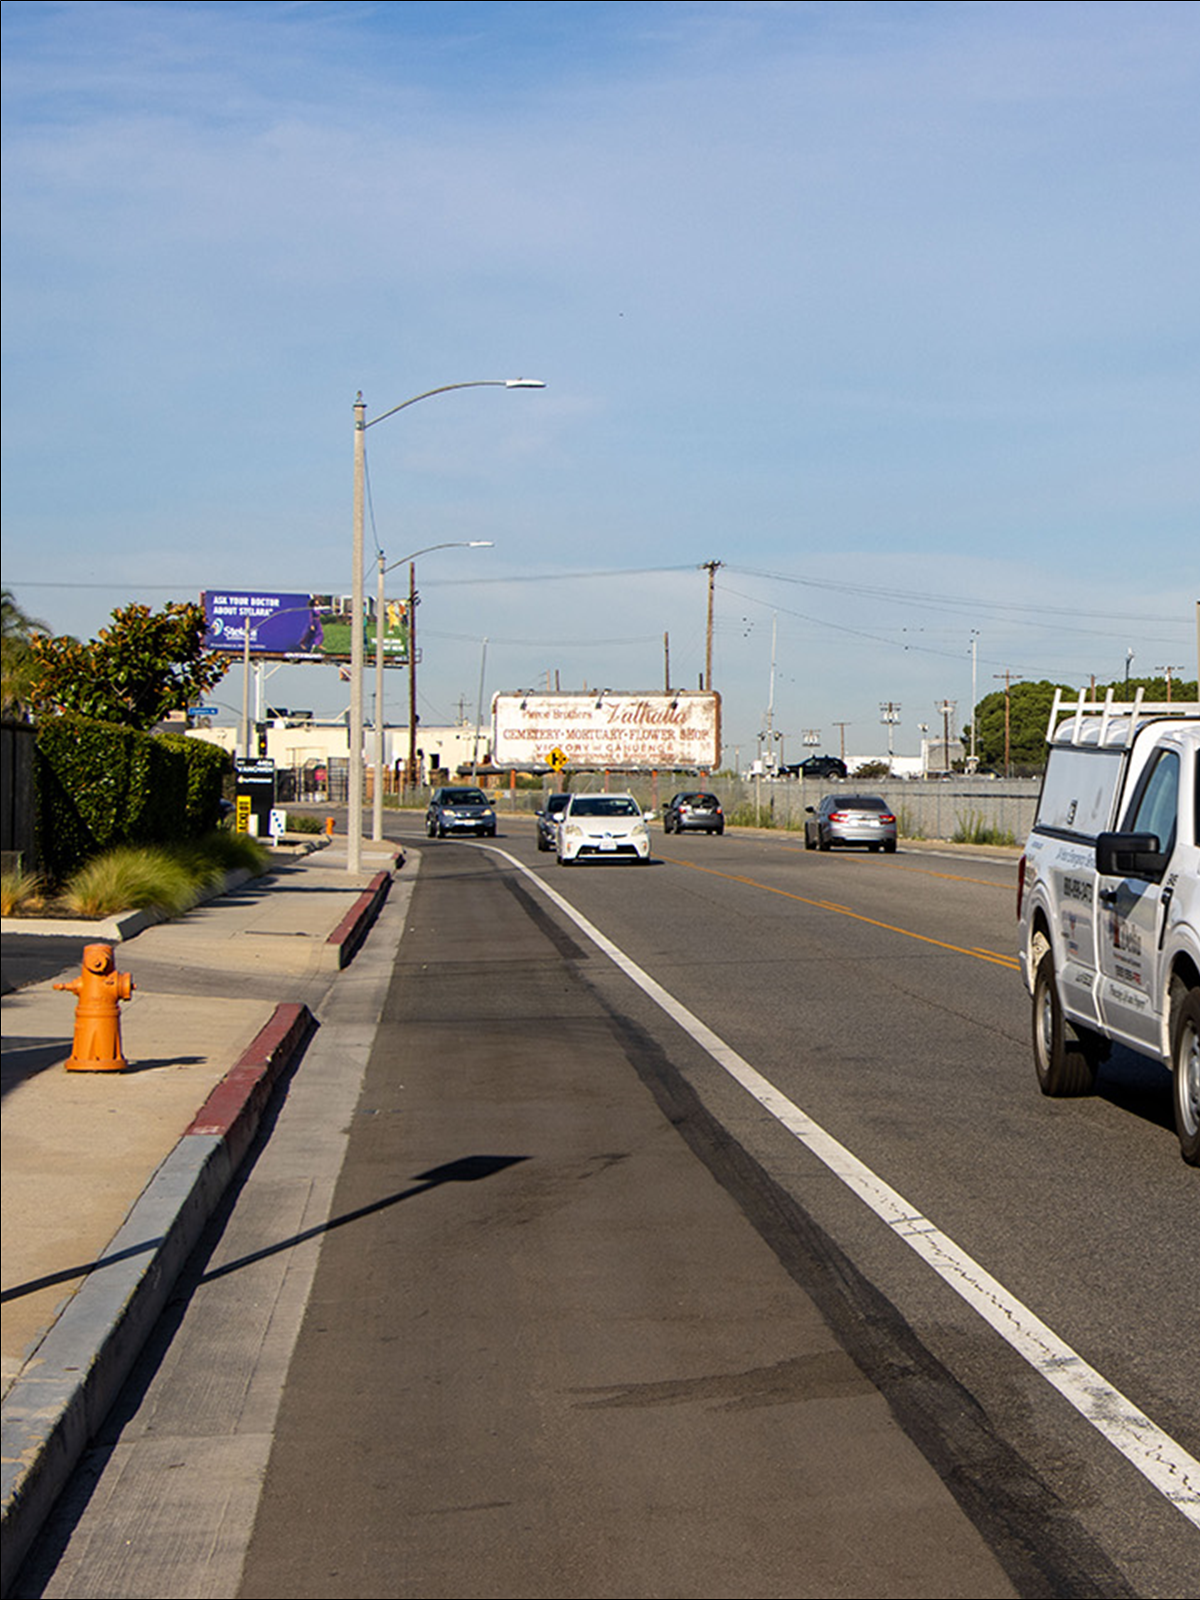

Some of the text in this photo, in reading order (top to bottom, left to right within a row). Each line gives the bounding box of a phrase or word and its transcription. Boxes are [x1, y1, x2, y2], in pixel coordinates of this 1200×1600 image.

[213, 596, 280, 607] ASK YOUR DOCTOR
[213, 606, 238, 615] ABOUT
[553, 709, 592, 720] Brothers
[605, 701, 687, 724] Valhalla
[503, 727, 710, 741] CEMETERY MORTUARY FLOWER SHOP
[535, 743, 590, 752] VICTORY
